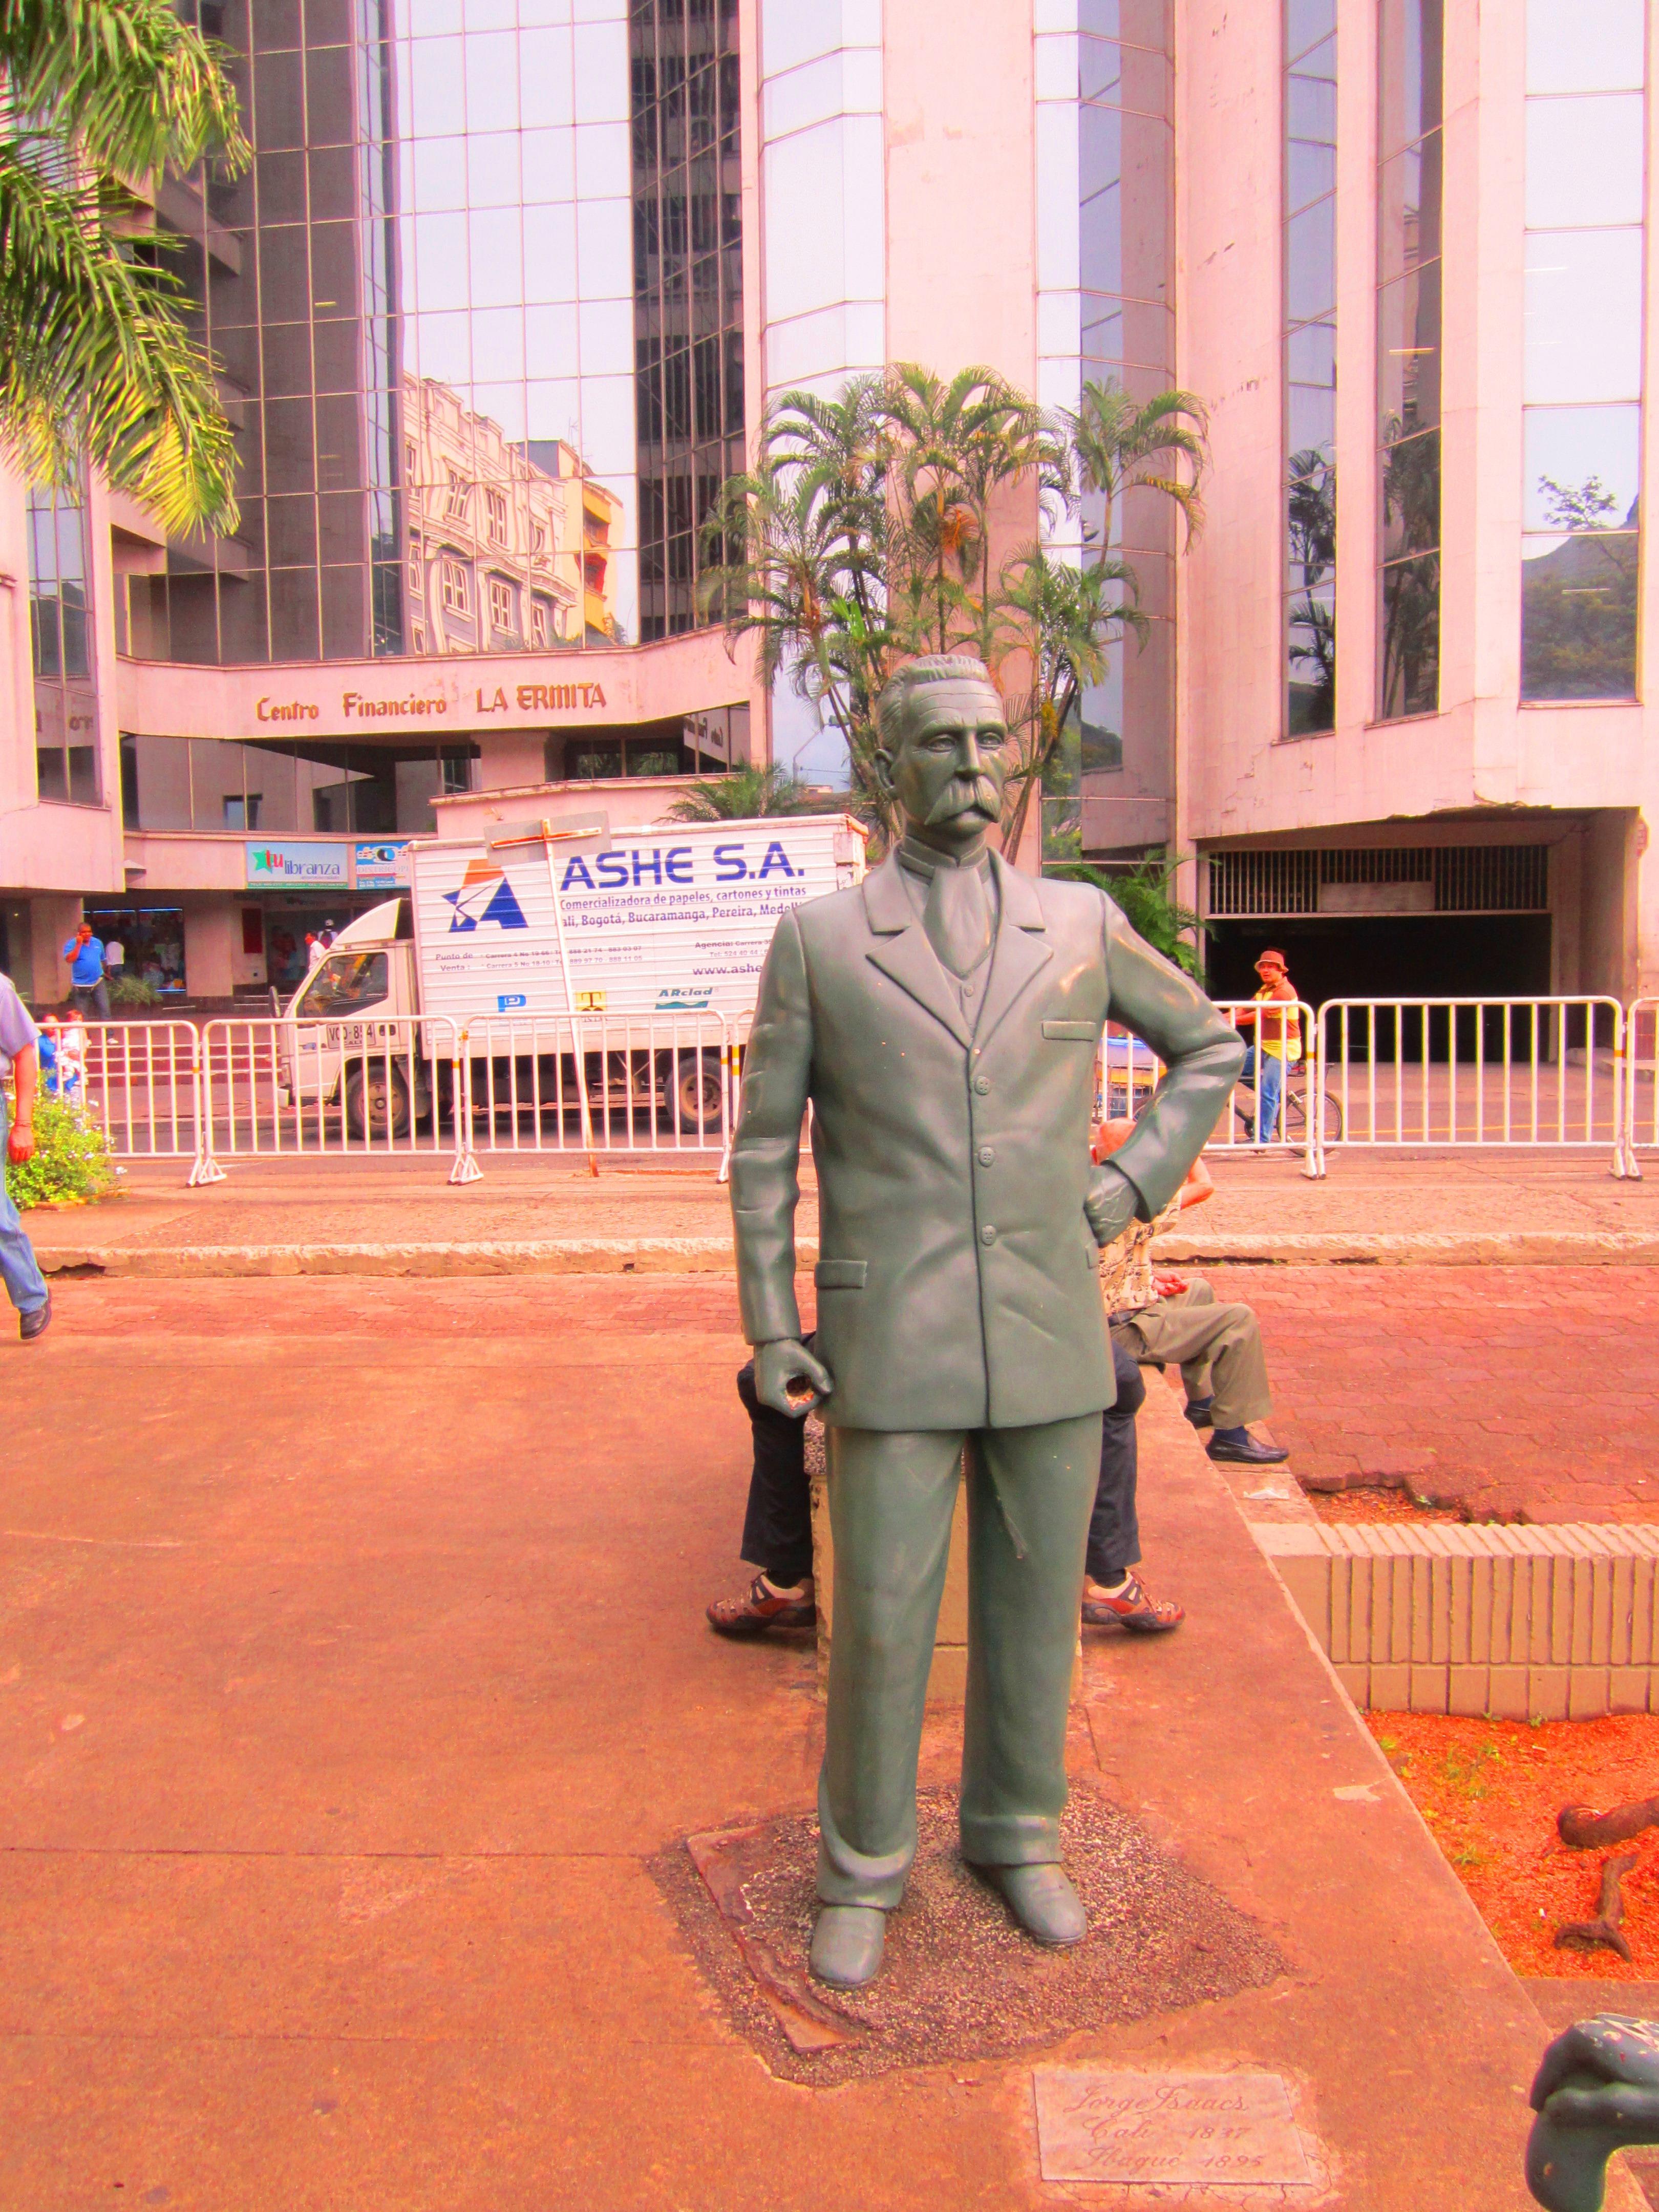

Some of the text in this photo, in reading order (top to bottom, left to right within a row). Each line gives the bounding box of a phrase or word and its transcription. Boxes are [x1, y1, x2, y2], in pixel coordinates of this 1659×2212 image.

[257, 683, 606, 721] Centro Financiero LA ERMITA
[266, 849, 340, 875] tu libranza
[560, 841, 805, 891] ASHE S.A.
[560, 886, 806, 910] Comercializadora de papeles, cartones y tintas
[562, 915, 579, 927] ali,
[582, 912, 625, 928] Bogotá,
[628, 910, 709, 923] Bucaramanga,
[712, 905, 757, 918] Pereira,
[1063, 2084, 1249, 2118] Jorge Isaacs
[1082, 2116, 1153, 2140] Cali
